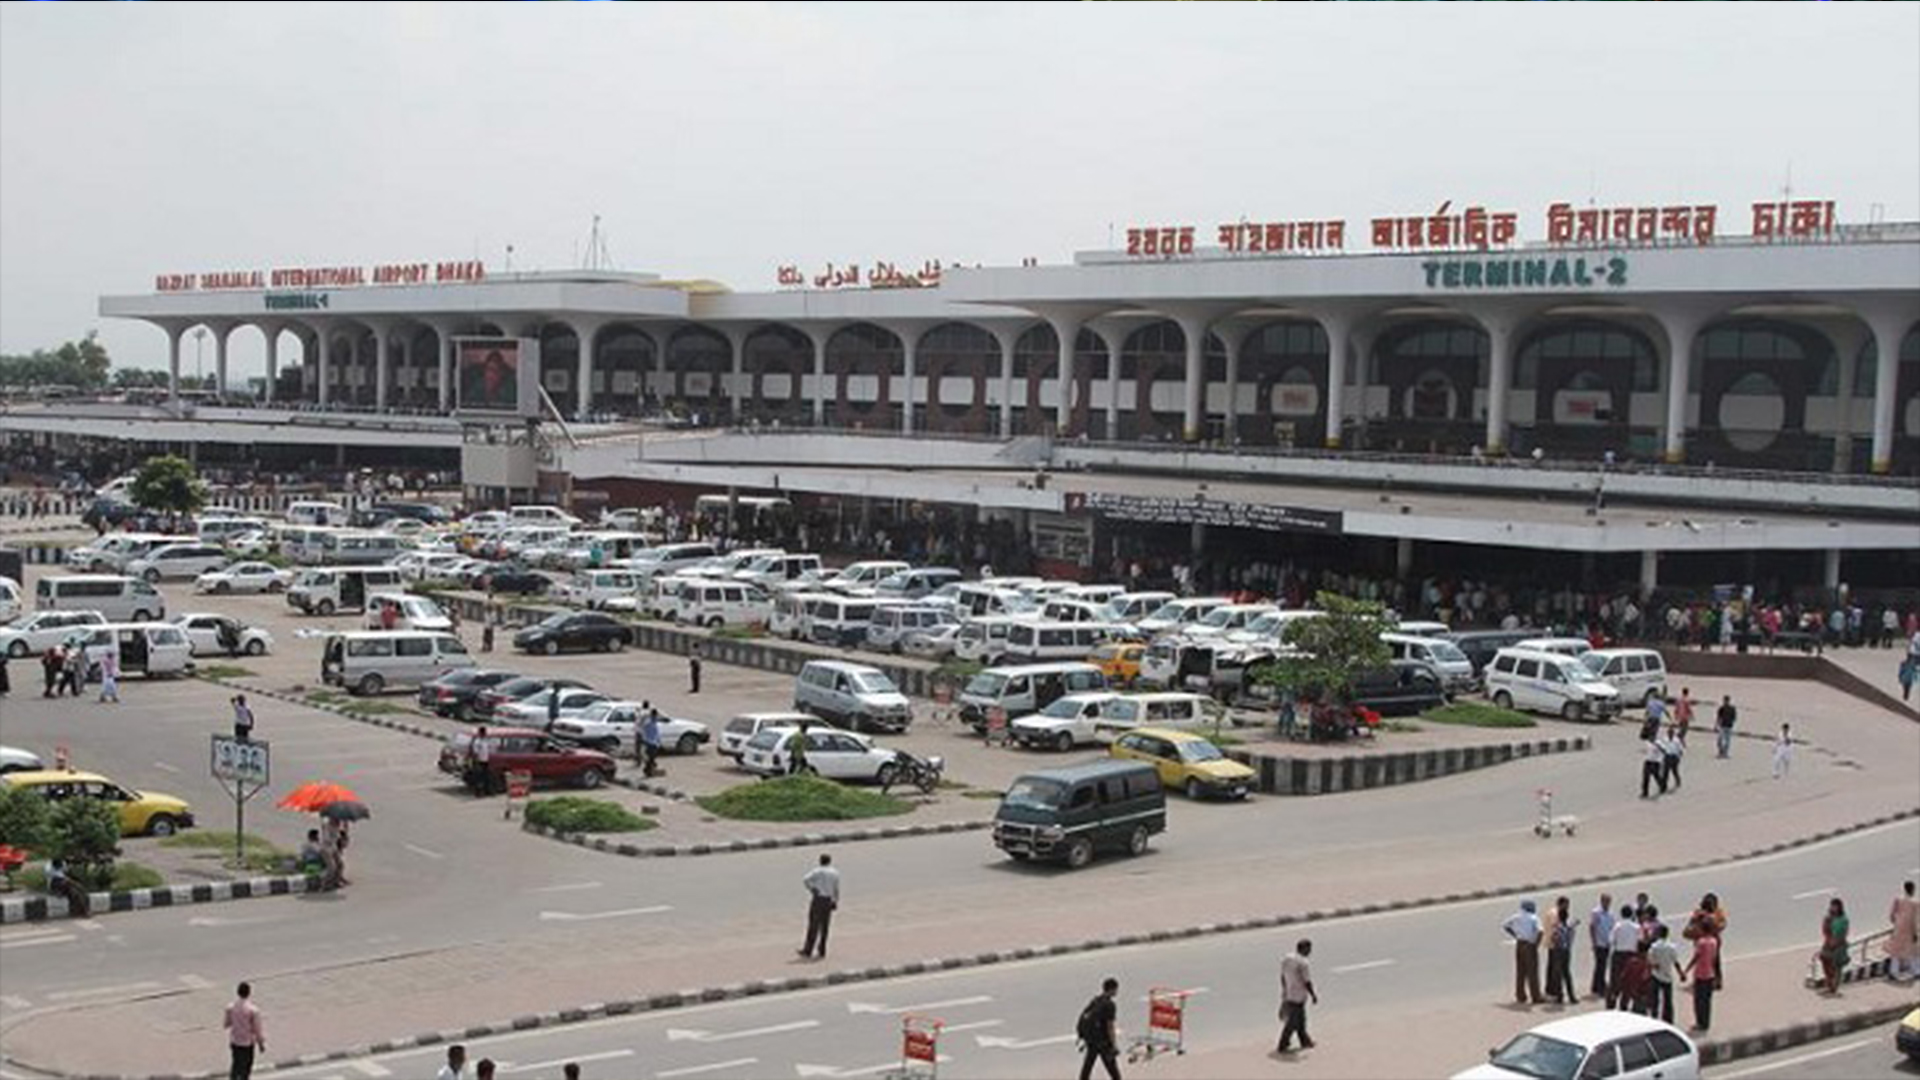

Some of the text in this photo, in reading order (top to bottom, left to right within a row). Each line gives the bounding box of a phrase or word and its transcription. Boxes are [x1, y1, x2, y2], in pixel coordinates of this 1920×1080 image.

[1752, 201, 1835, 240] ঢাকা
[373, 264, 428, 283] AIRPORT
[1422, 258, 1628, 288] TERMINAL-2
